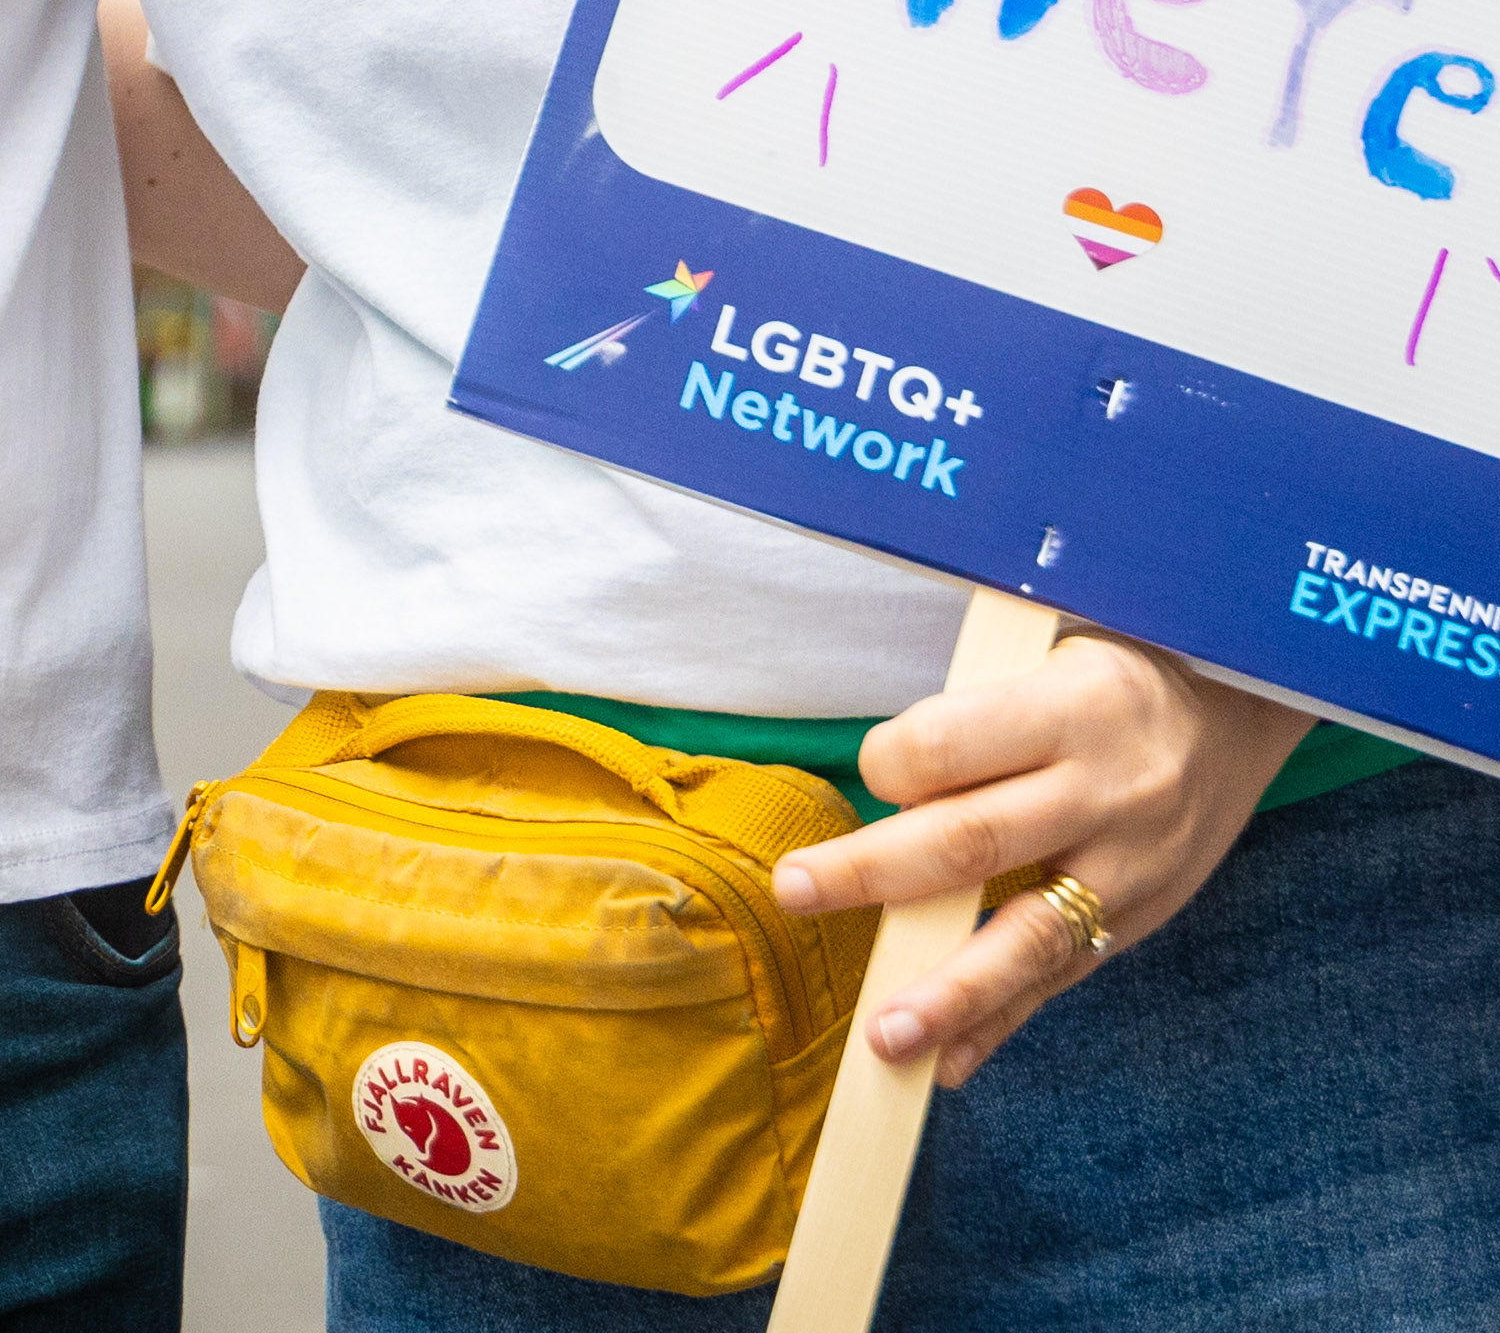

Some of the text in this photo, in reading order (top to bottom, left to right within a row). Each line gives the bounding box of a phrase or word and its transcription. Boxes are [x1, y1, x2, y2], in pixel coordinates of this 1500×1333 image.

[710, 303, 985, 427] LGBTQ+
[678, 360, 966, 499] Network
[363, 1057, 501, 1151] FJÄLLRÄVEN
